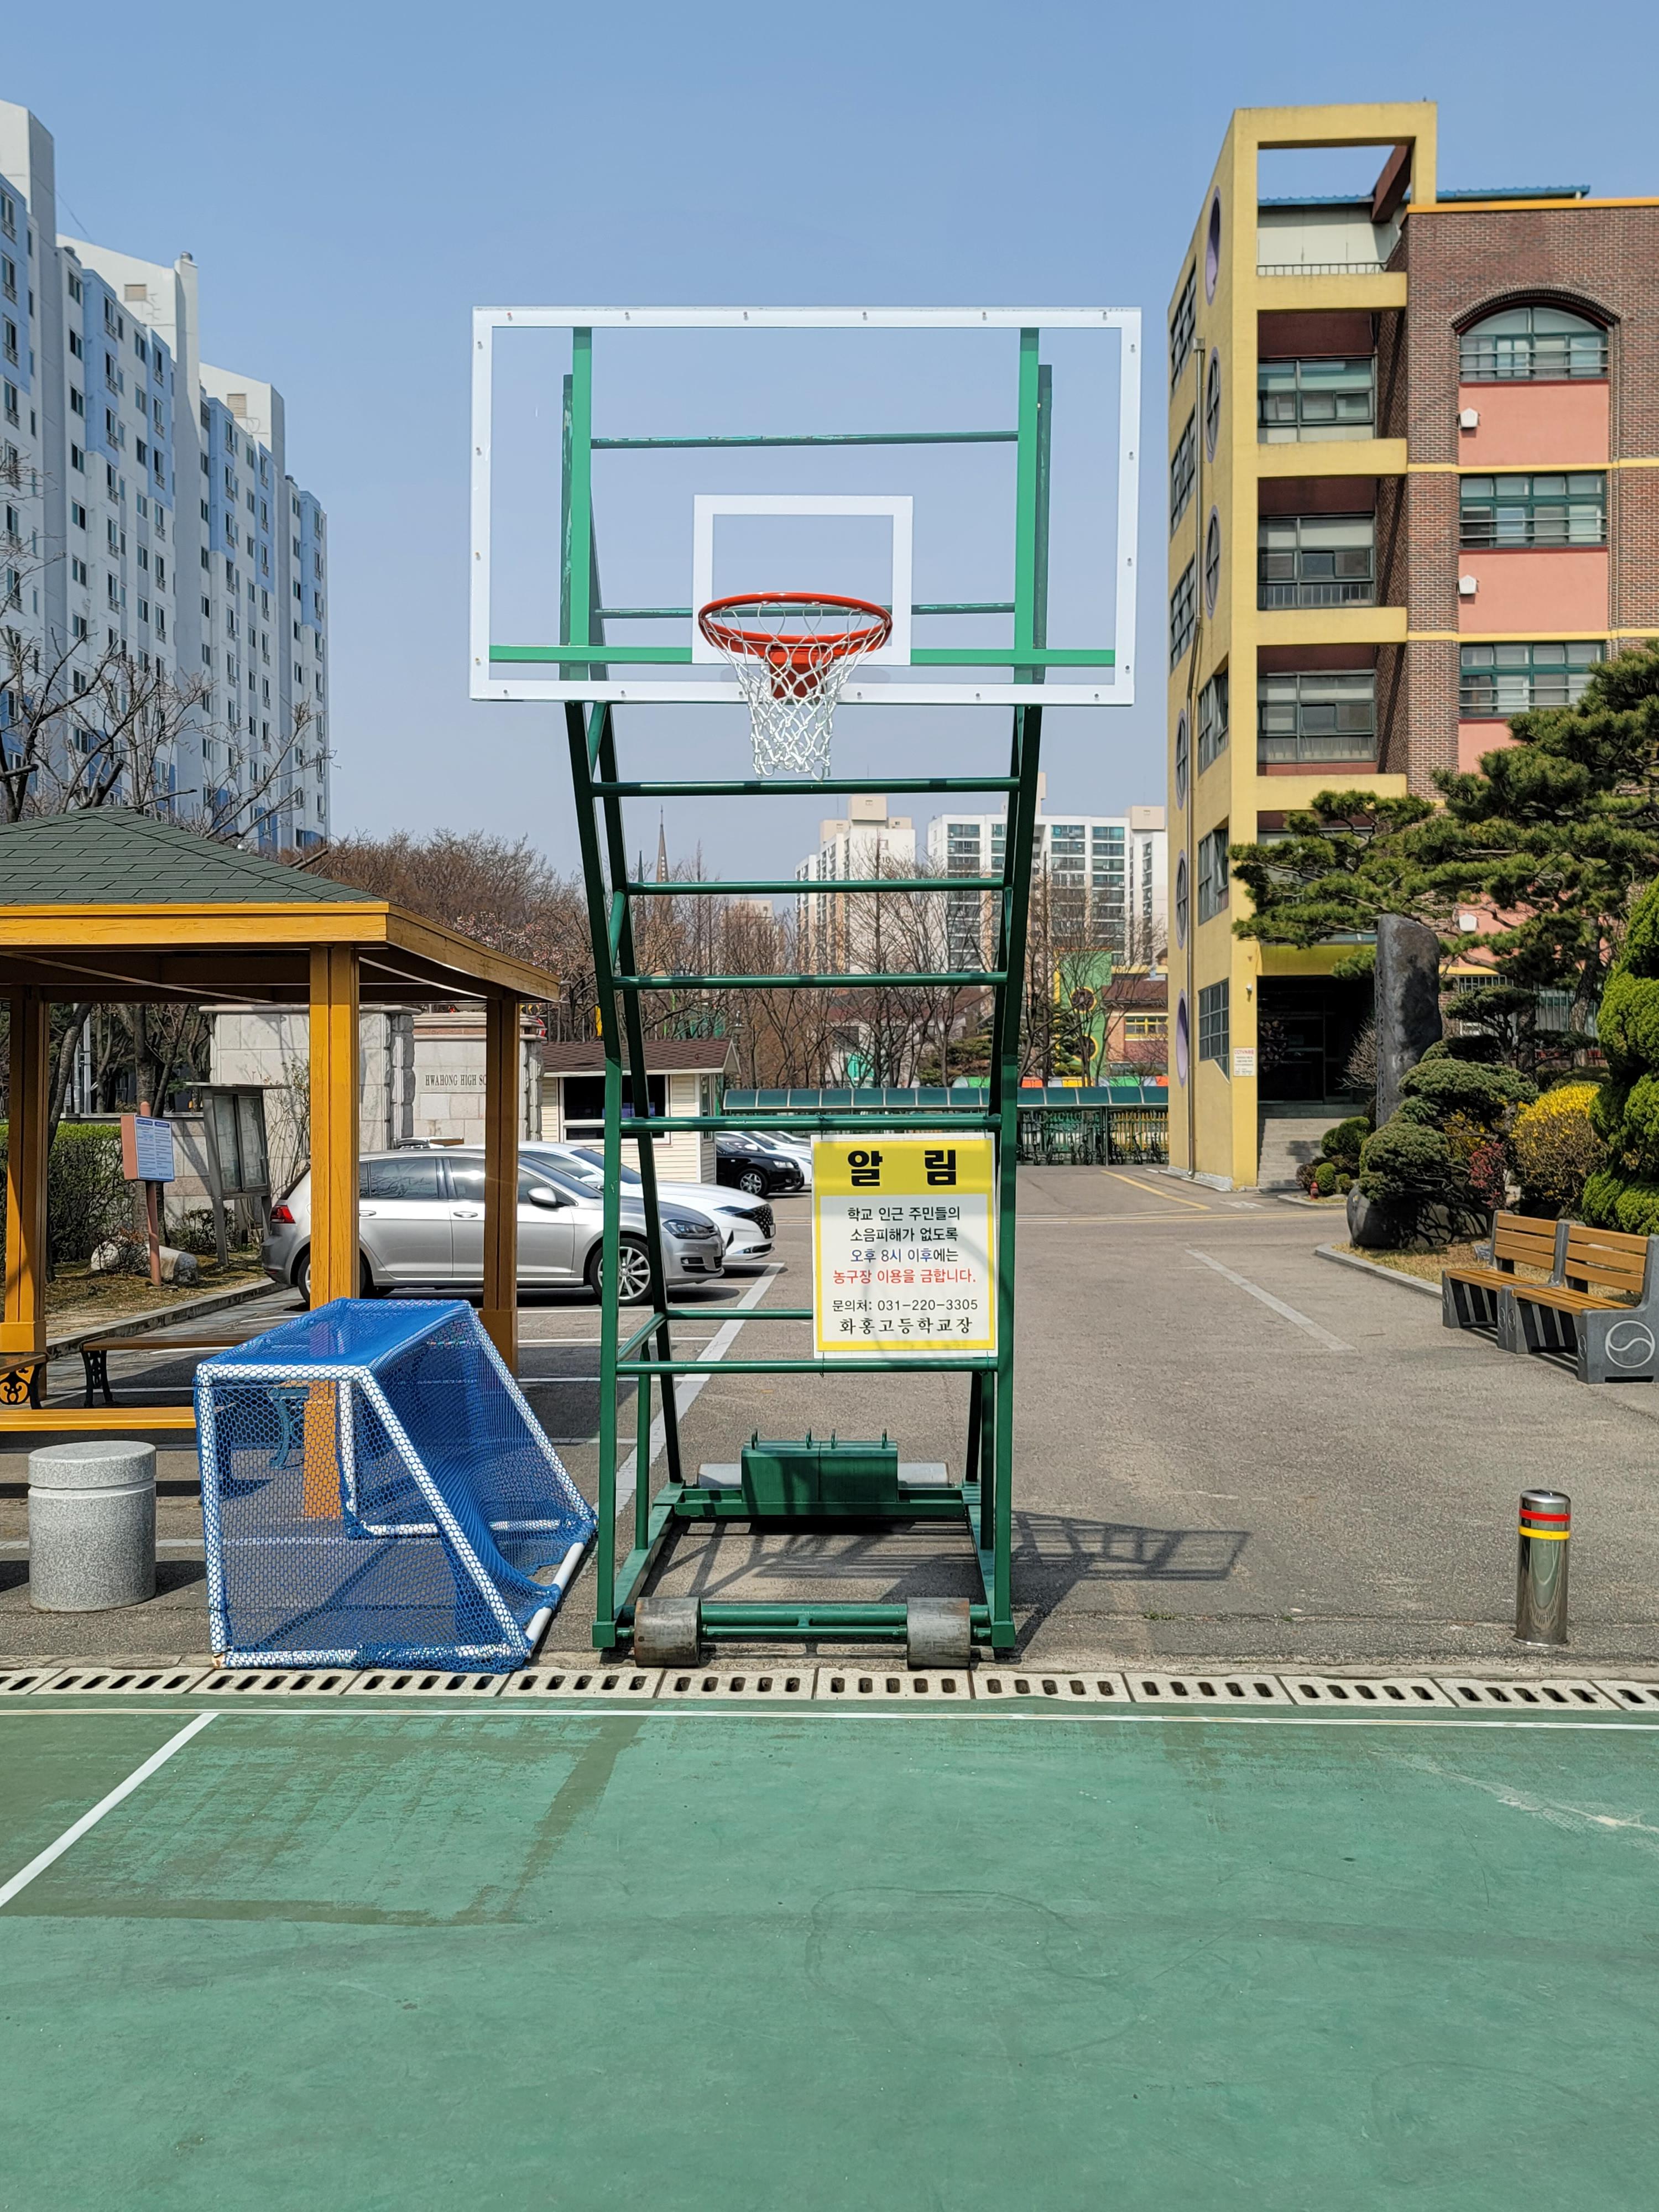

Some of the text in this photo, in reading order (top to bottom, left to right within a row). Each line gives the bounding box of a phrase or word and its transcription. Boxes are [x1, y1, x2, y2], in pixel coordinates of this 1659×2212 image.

[425, 1074, 458, 1086] HWAHONG
[460, 1074, 477, 1086] HIGH
[847, 1206, 960, 1222] 학교 인근 주민들의
[851, 1227, 958, 1242] 소음피해가 없도록
[851, 1248, 958, 1263] 오후 8시 이후에는
[833, 1269, 975, 1284] 농구장 이용을 금합니다.
[832, 1299, 978, 1312] 문의처: 031-220-3305
[840, 1317, 972, 1335] 화홍고등학교장
